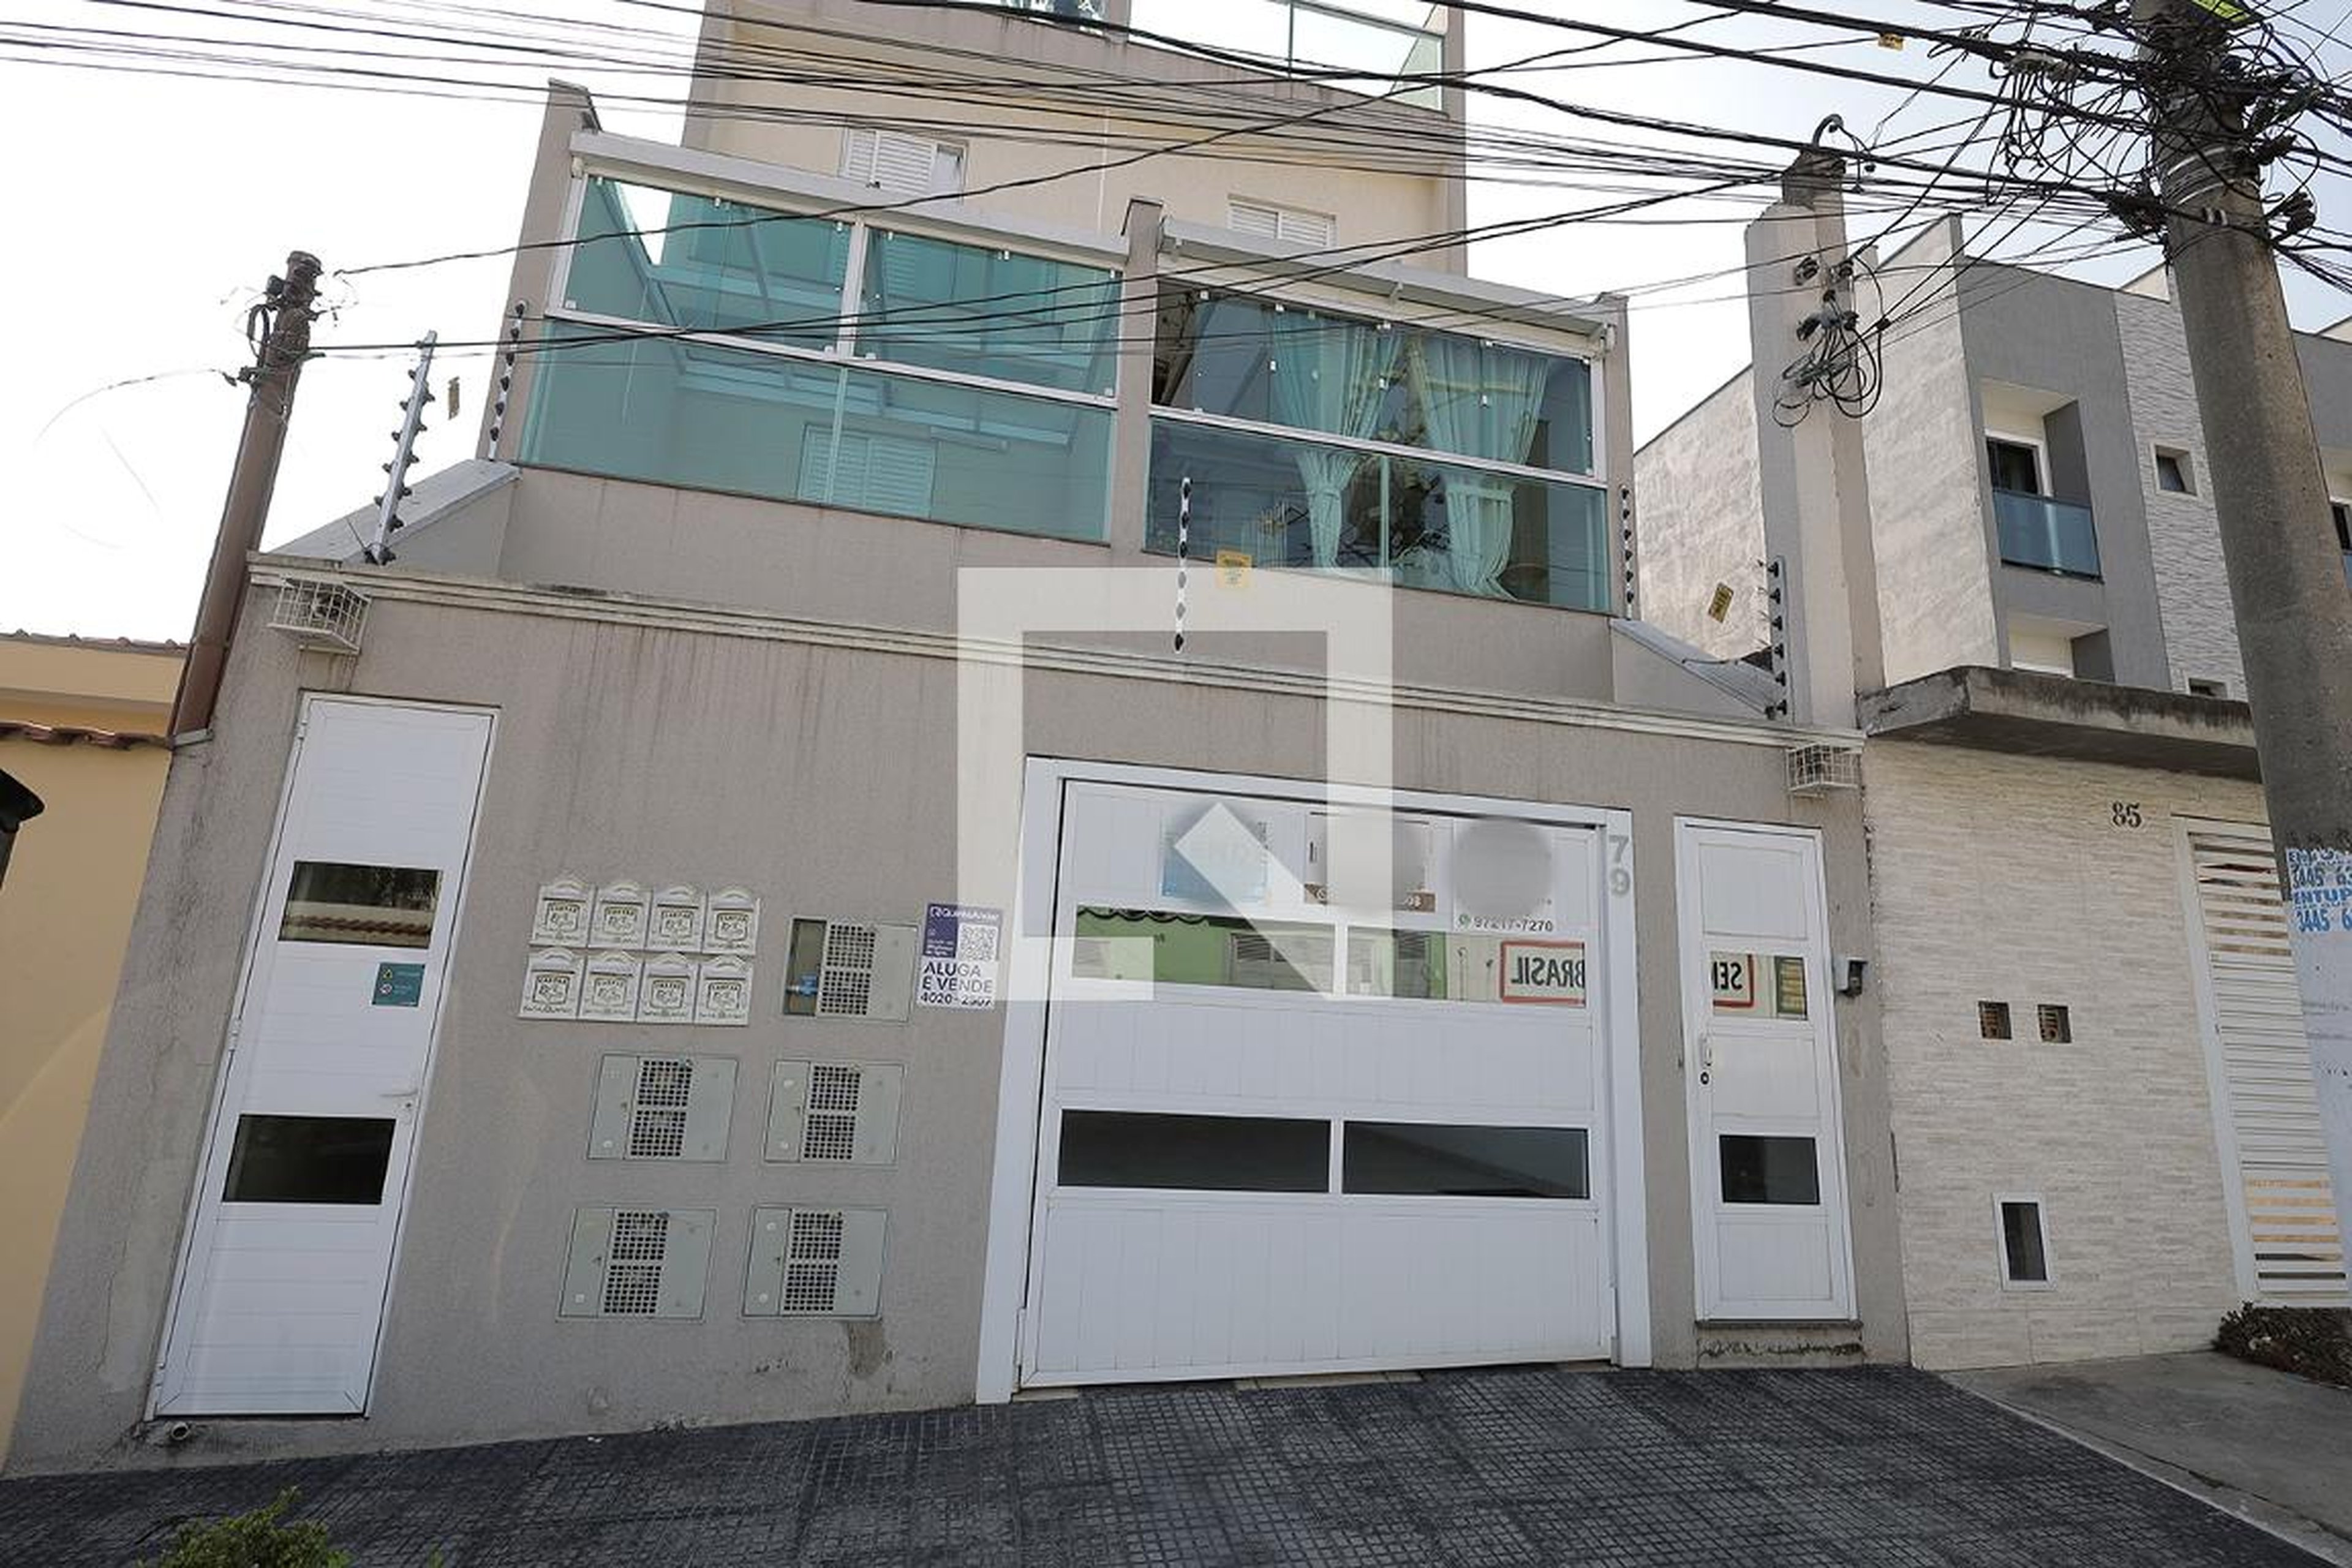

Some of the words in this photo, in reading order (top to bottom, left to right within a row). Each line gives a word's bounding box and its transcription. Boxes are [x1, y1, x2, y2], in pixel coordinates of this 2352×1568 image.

[2113, 801, 2142, 828] 85
[924, 961, 981, 978] ALUGA
[923, 975, 932, 990] E
[937, 977, 993, 993] VENDE
